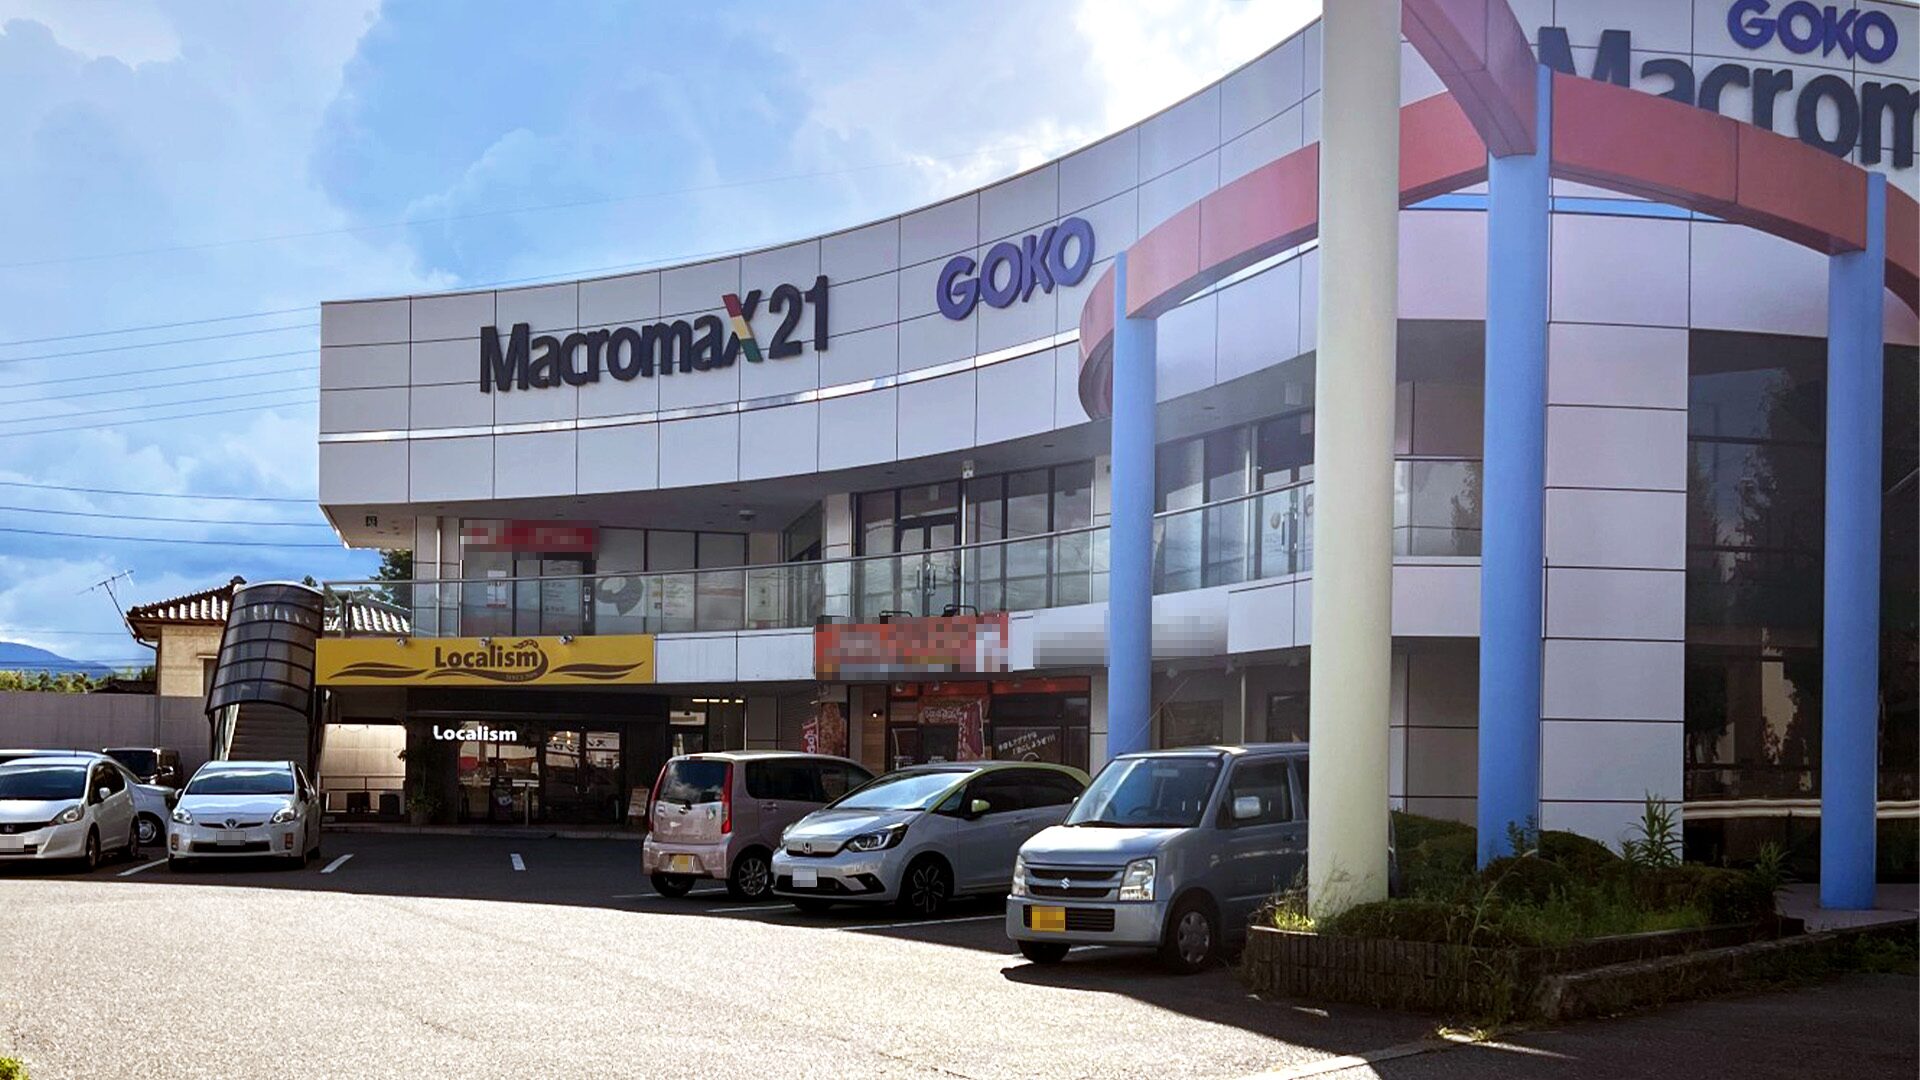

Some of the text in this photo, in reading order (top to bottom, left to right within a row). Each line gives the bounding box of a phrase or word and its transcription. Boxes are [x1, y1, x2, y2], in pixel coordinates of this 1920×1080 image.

[1727, 0, 1898, 63] GOKO
[936, 216, 1095, 321] GOKO
[435, 646, 538, 668] Localism
[433, 725, 517, 742] Localism
